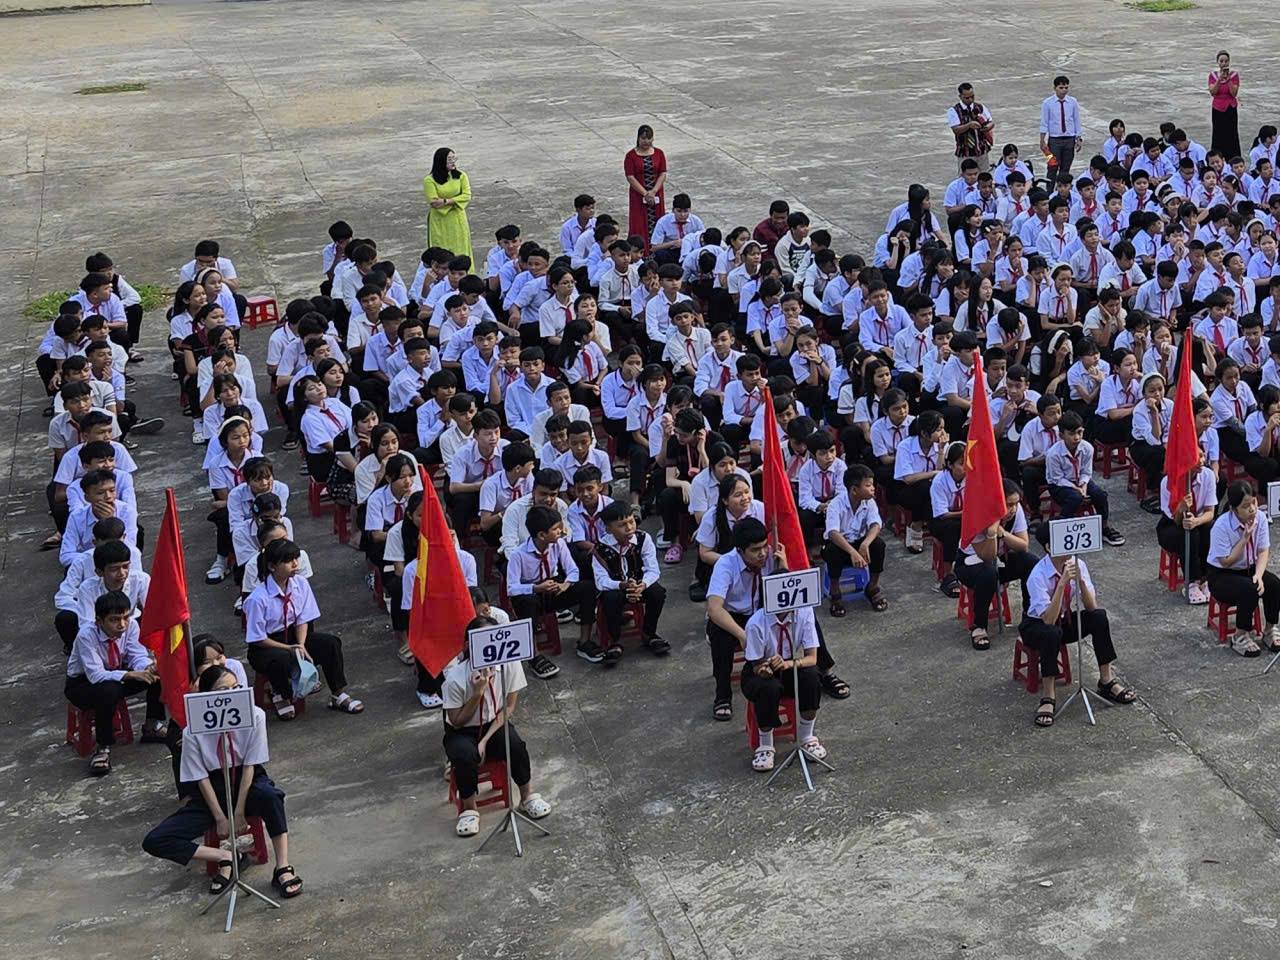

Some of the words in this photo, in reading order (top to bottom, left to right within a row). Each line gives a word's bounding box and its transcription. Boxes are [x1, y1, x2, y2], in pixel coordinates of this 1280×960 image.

[1067, 522, 1085, 533] LỚP
[1064, 532, 1092, 550] 8/3
[782, 577, 801, 589] LỚP
[778, 588, 808, 607] 9/1
[490, 630, 511, 641] LỚP
[483, 640, 520, 662] 9/2
[206, 696, 232, 708] LỚP
[203, 708, 241, 729] 9/3
